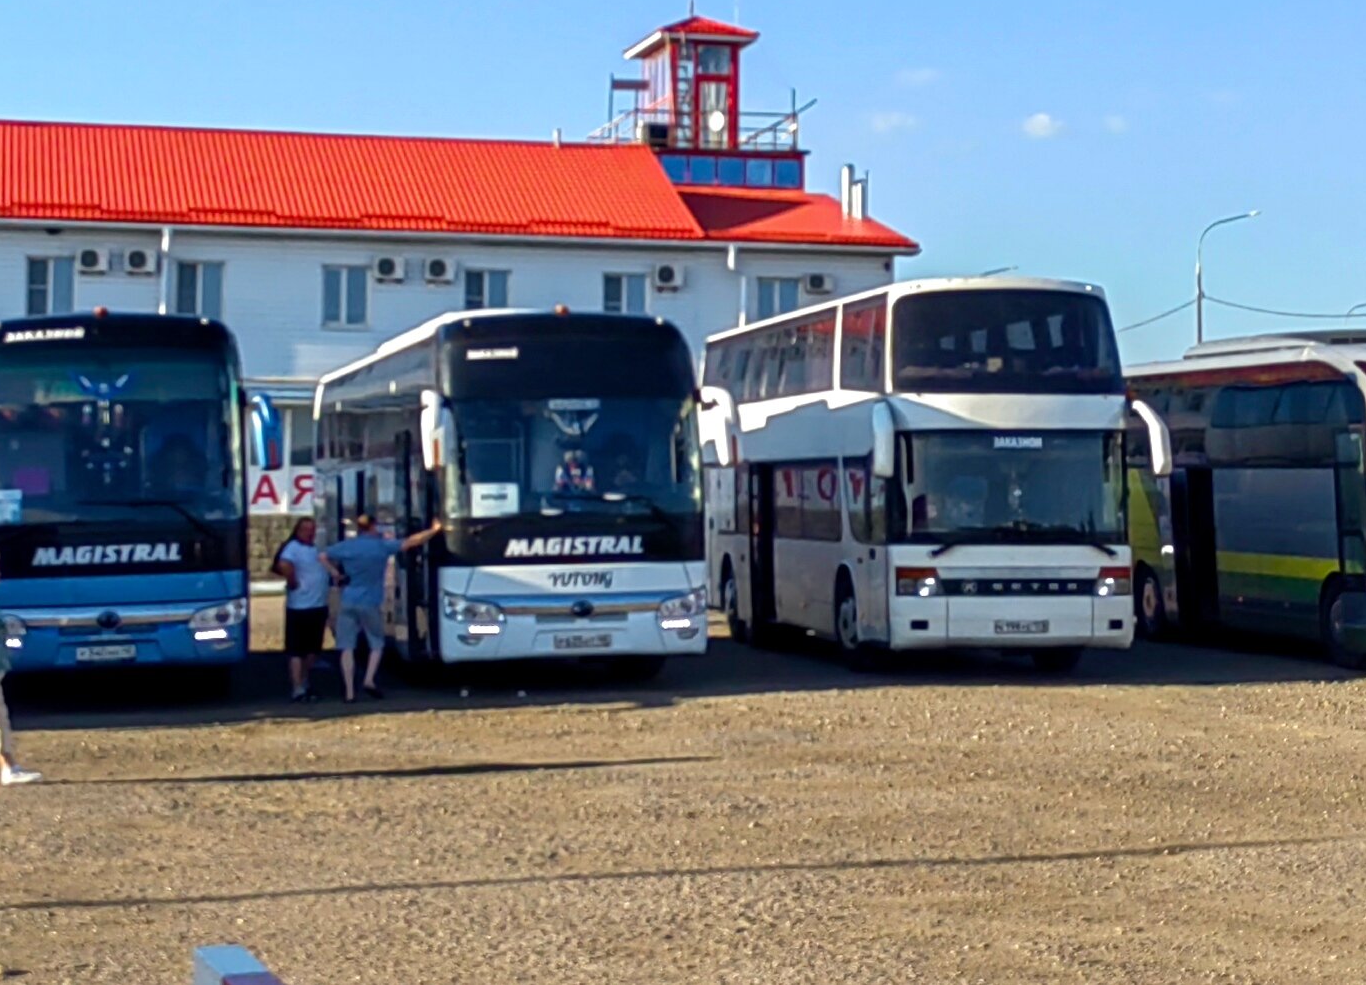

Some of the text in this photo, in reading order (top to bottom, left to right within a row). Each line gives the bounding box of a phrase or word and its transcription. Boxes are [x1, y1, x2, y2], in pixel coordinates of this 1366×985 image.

[31, 542, 182, 566] MAGISTRAL
[504, 535, 644, 558] MAGISTRAL
[548, 570, 613, 589] YUTONG
